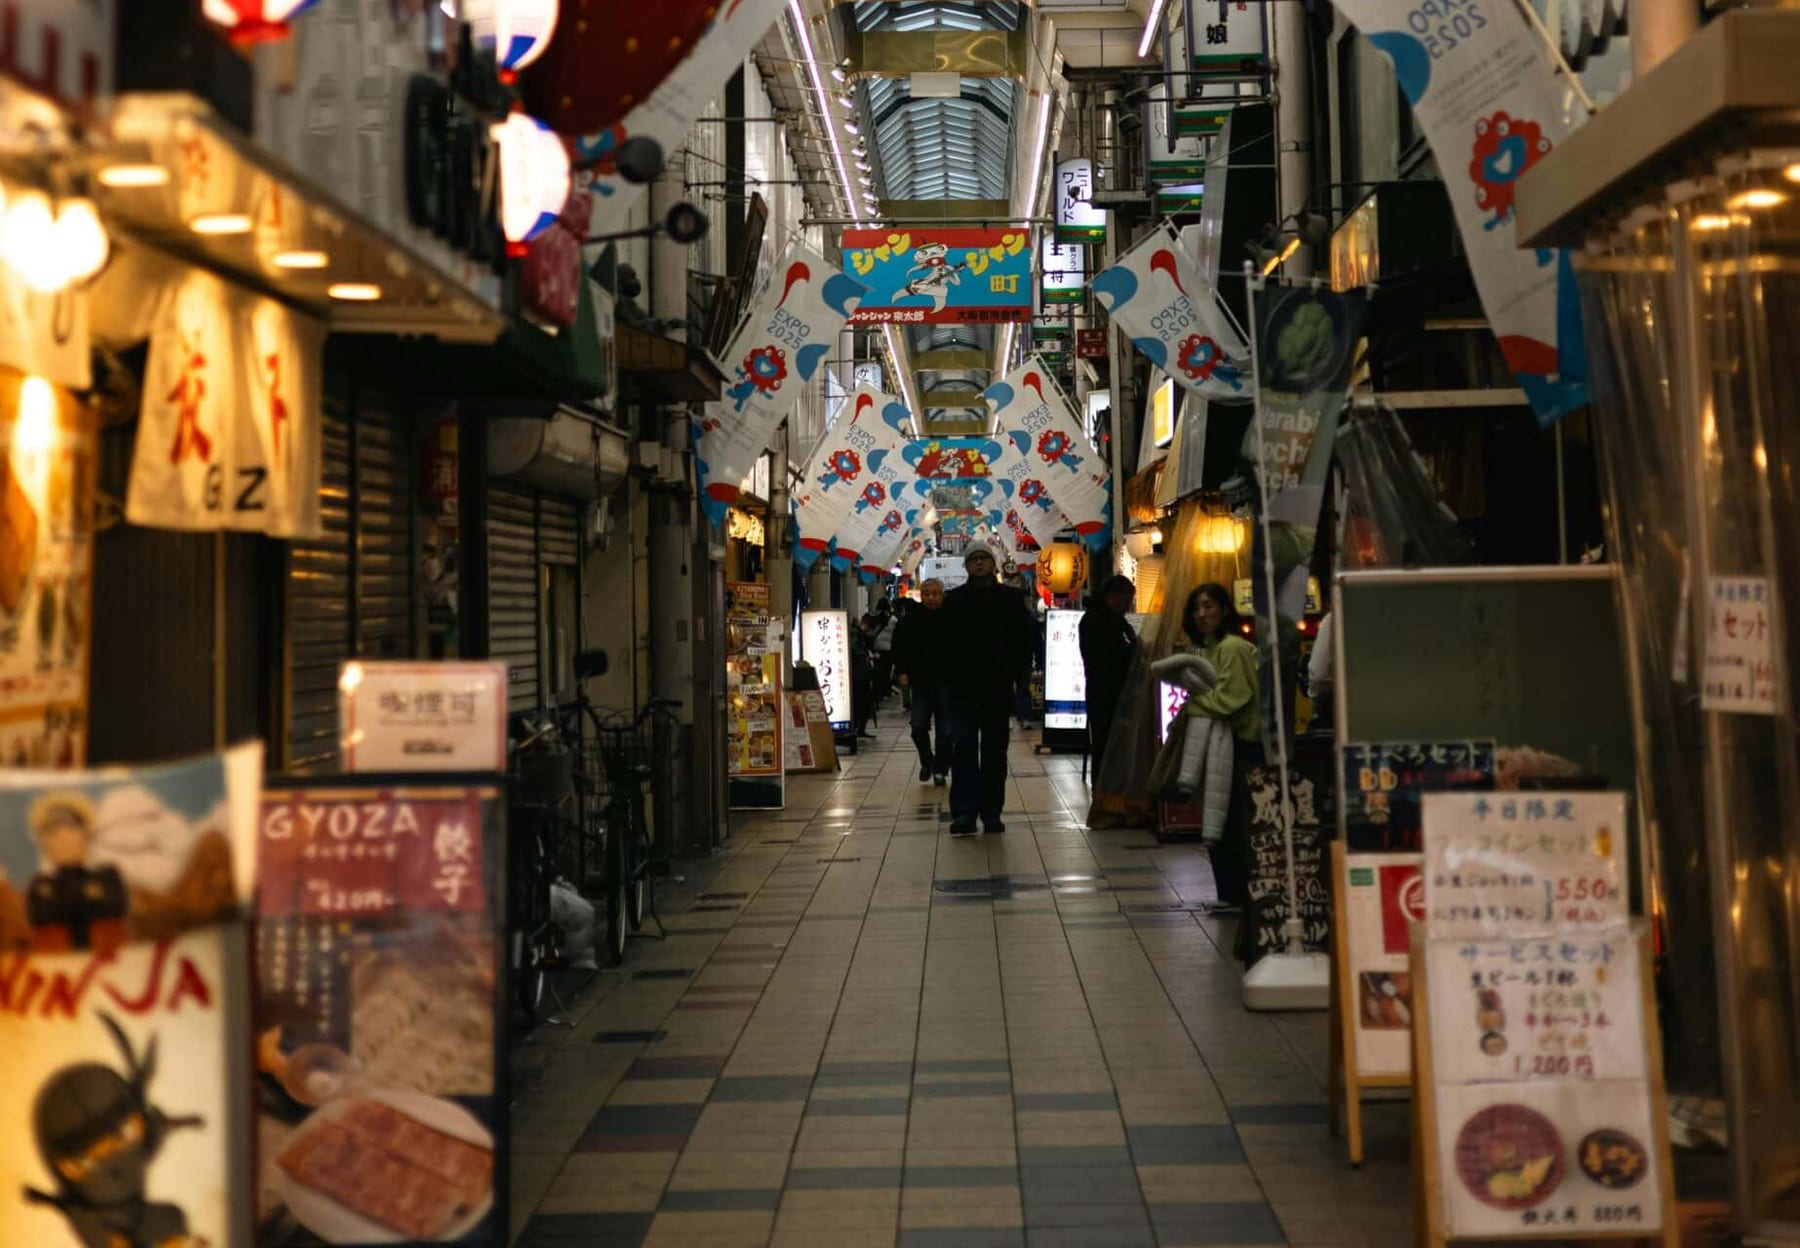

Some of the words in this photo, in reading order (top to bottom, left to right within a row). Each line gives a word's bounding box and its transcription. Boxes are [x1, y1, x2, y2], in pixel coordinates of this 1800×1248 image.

[990, 274, 1021, 294] 町
[774, 307, 811, 338] EXPO
[766, 320, 804, 351] 2025
[844, 432, 870, 453] 2025
[849, 424, 876, 446] EXPO
[264, 802, 420, 840] GYOZA
[1471, 799, 1575, 822] 平日限定
[1460, 942, 1614, 965] サービスセット
